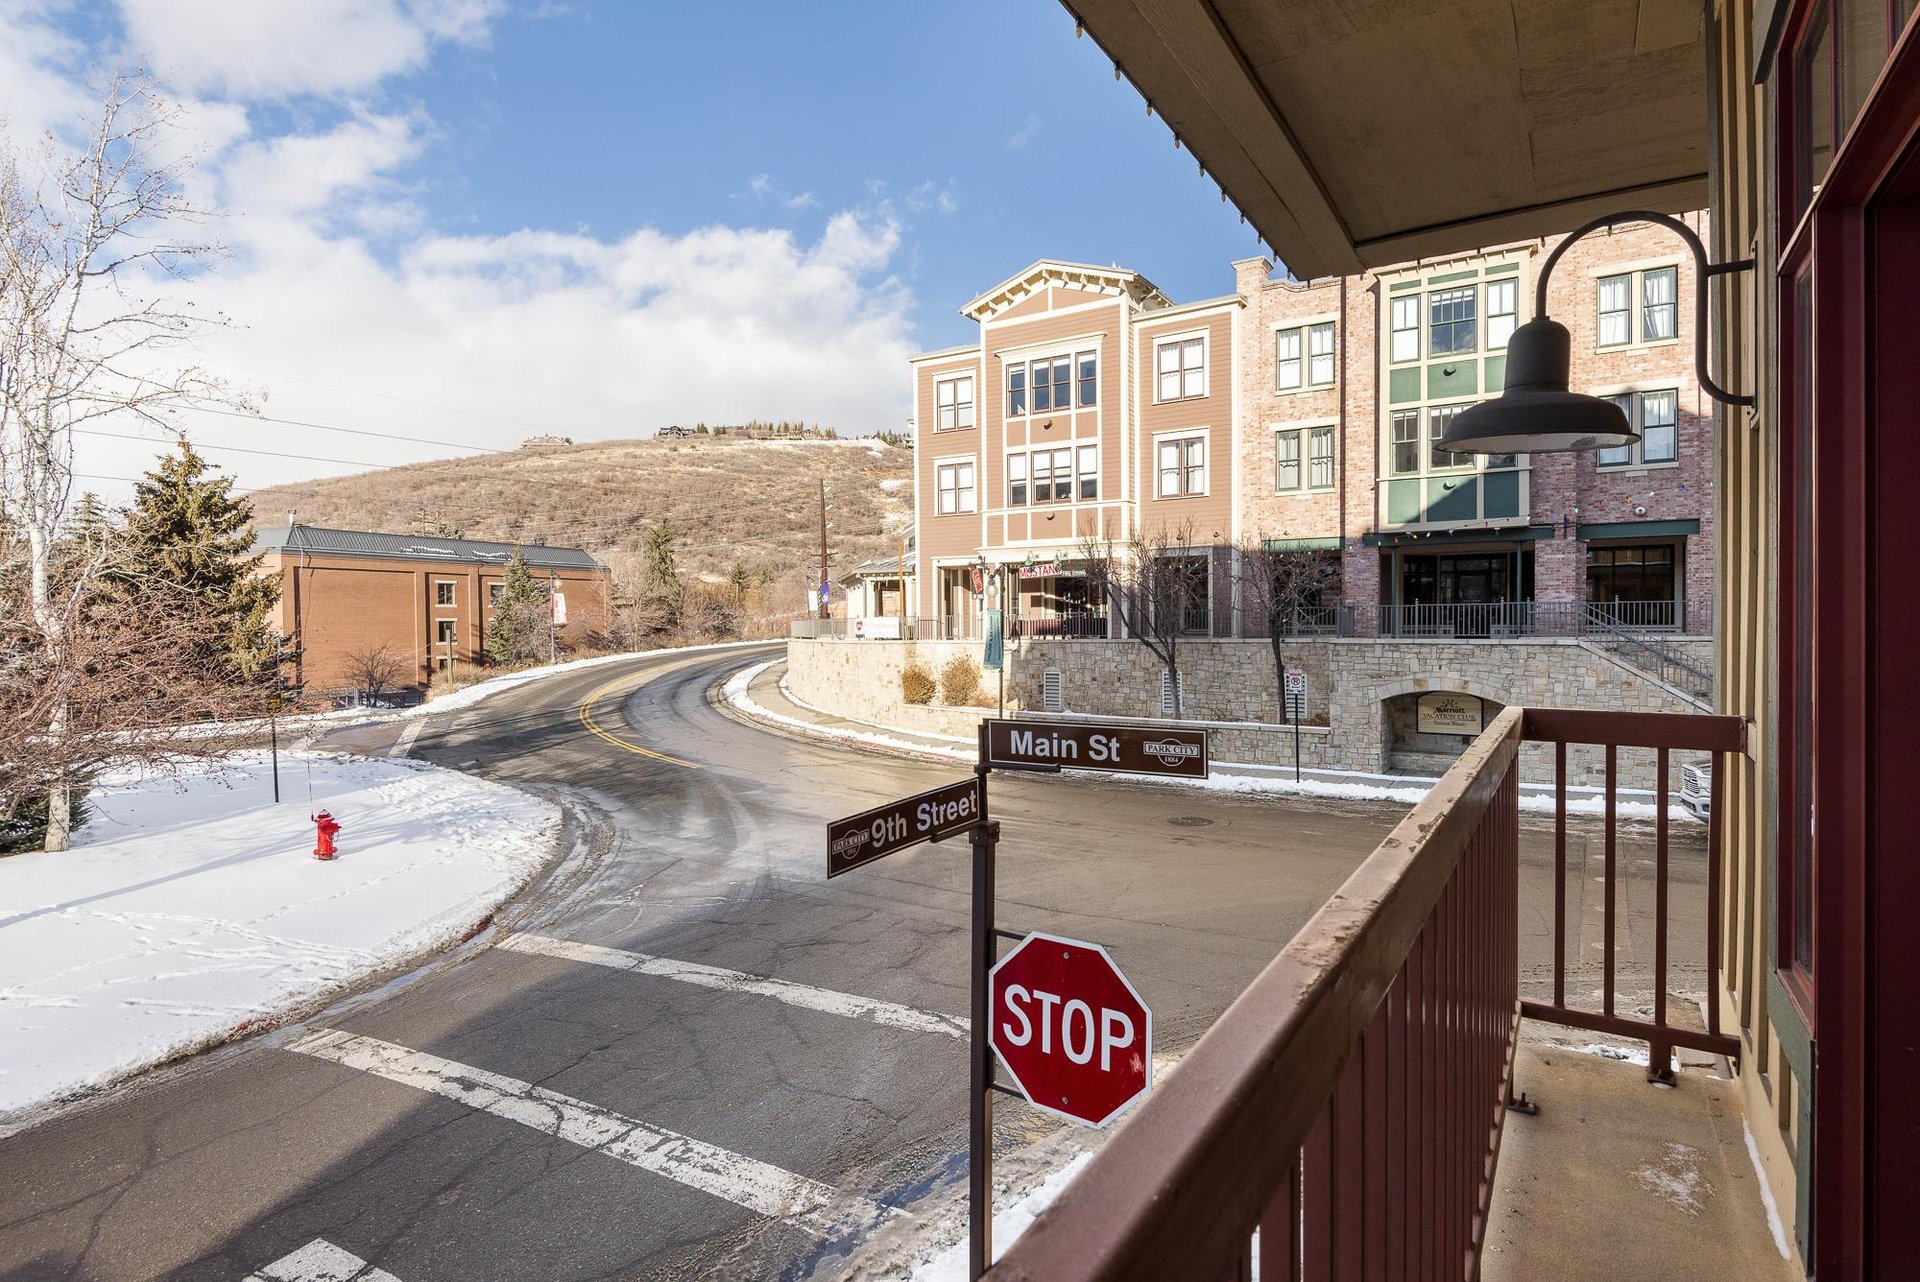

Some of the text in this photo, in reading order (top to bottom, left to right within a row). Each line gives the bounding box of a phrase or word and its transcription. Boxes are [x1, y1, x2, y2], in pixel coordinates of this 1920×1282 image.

[1422, 712, 1456, 720] VACATION
[1434, 706, 1466, 714] Marriott
[1010, 730, 1120, 762] Main St
[1147, 744, 1195, 755] PARK CITY
[871, 790, 976, 848] 9th Street
[1003, 984, 1134, 1072] STOP
